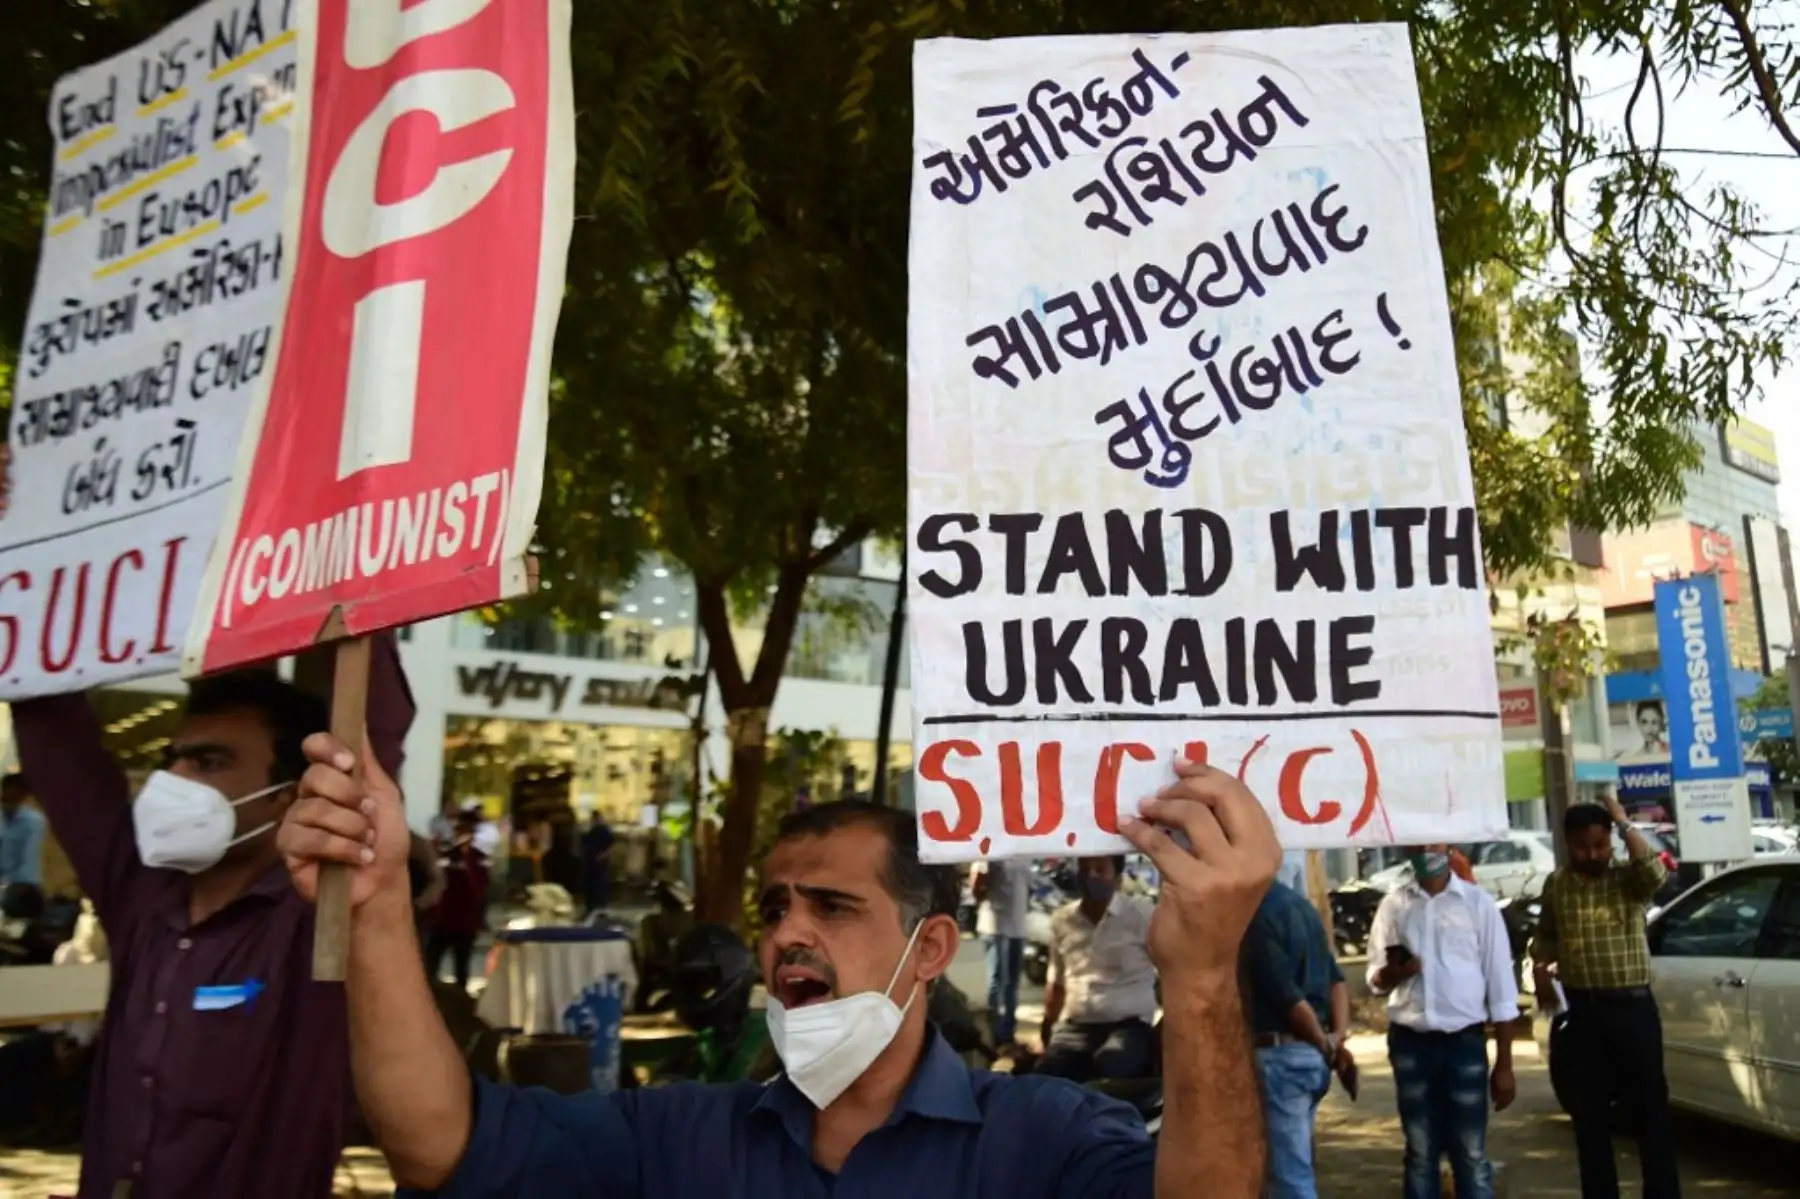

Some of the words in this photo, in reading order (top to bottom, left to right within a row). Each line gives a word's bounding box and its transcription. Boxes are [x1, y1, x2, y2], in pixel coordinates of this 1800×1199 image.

[58, 75, 117, 141] End
[1073, 76, 1310, 237] રશિયન
[99, 217, 126, 260] in
[221, 468, 511, 629] (COMMUNIST)
[917, 506, 1233, 598] STAND
[1271, 506, 1478, 592] WITH
[962, 615, 1382, 707] UKRAINE
[1673, 586, 1719, 769] Panasonic
